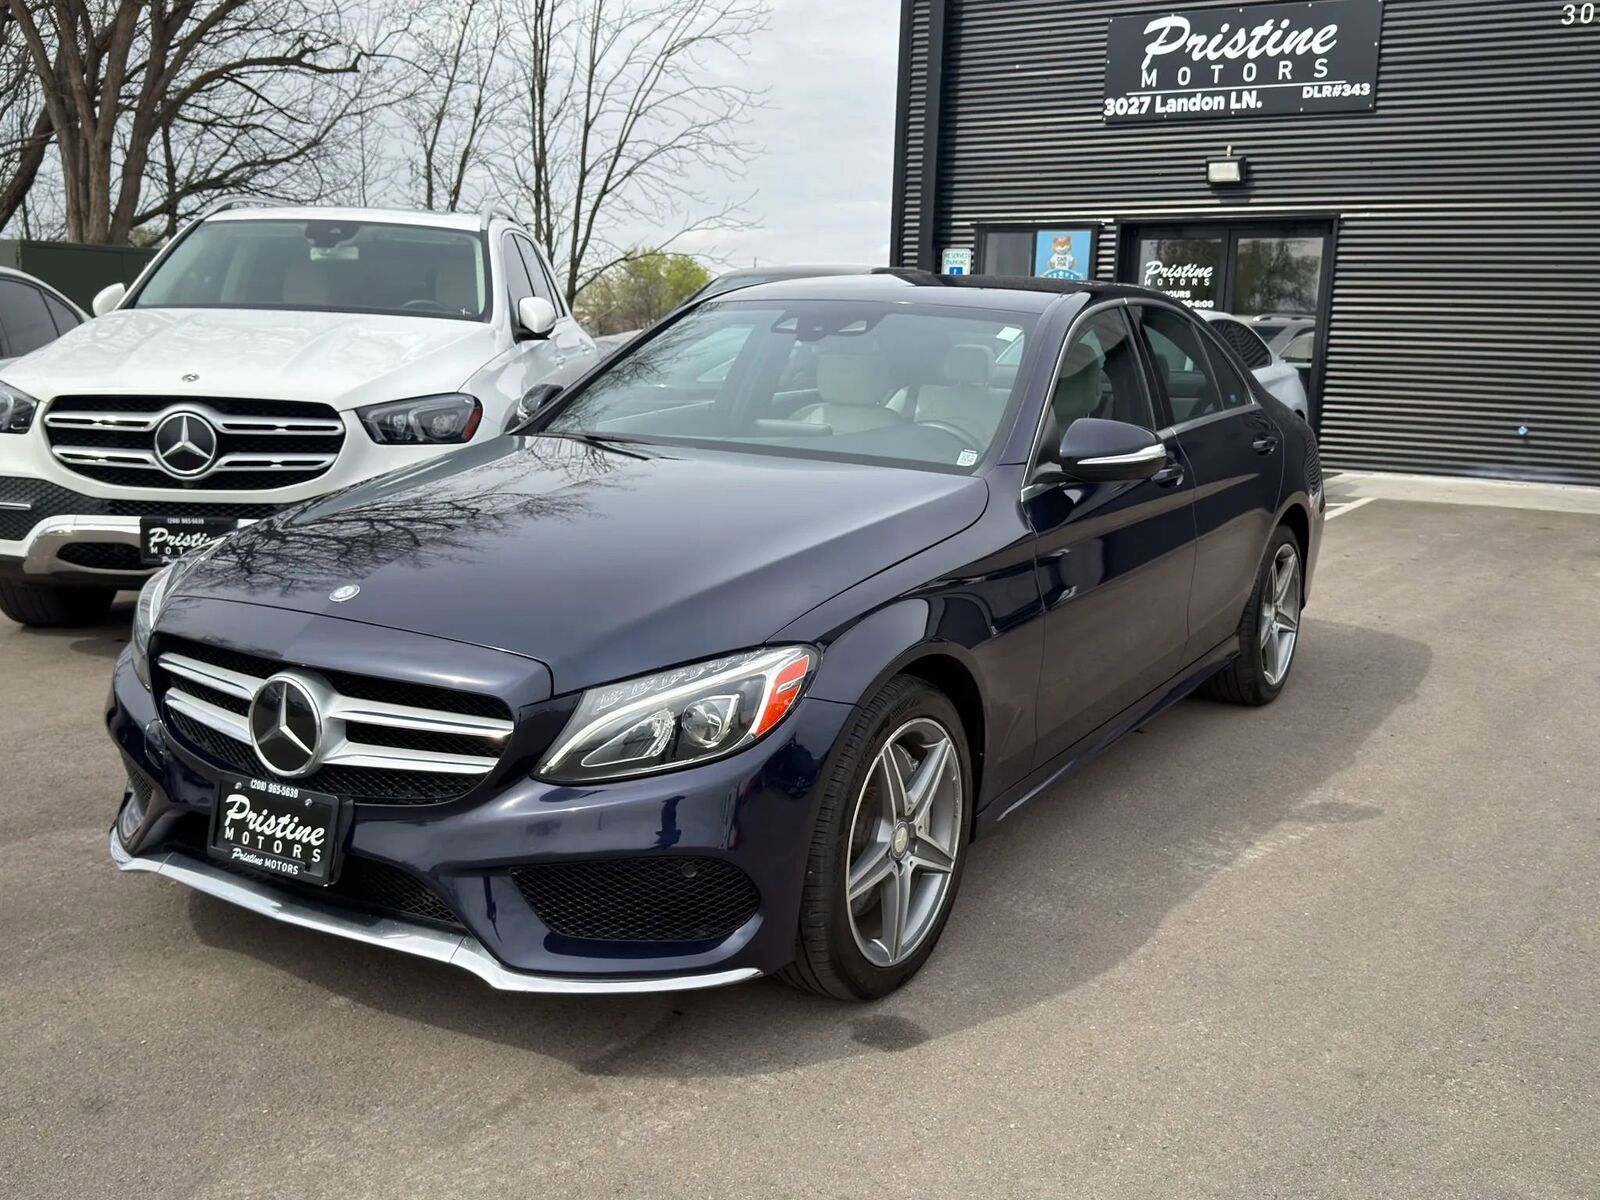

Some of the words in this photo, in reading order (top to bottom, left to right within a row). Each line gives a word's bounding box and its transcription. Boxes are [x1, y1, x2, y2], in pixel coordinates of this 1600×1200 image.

[1561, 3, 1600, 25] 30
[1141, 15, 1338, 70] Pristine
[1141, 57, 1329, 88] MOTORS
[1302, 82, 1371, 99] DLR#343
[1103, 96, 1151, 116] 3027
[1155, 92, 1225, 113] Landon
[1230, 90, 1262, 109] LN.
[1145, 260, 1213, 279] Pristine
[1143, 278, 1210, 287] MOTORS
[150, 546, 185, 555] MOT
[268, 783, 299, 798] 965-5639
[224, 793, 325, 846] Pristine
[224, 826, 321, 862] MOTORS
[231, 847, 263, 866] Pristine
[264, 858, 299, 875] MOTORS
